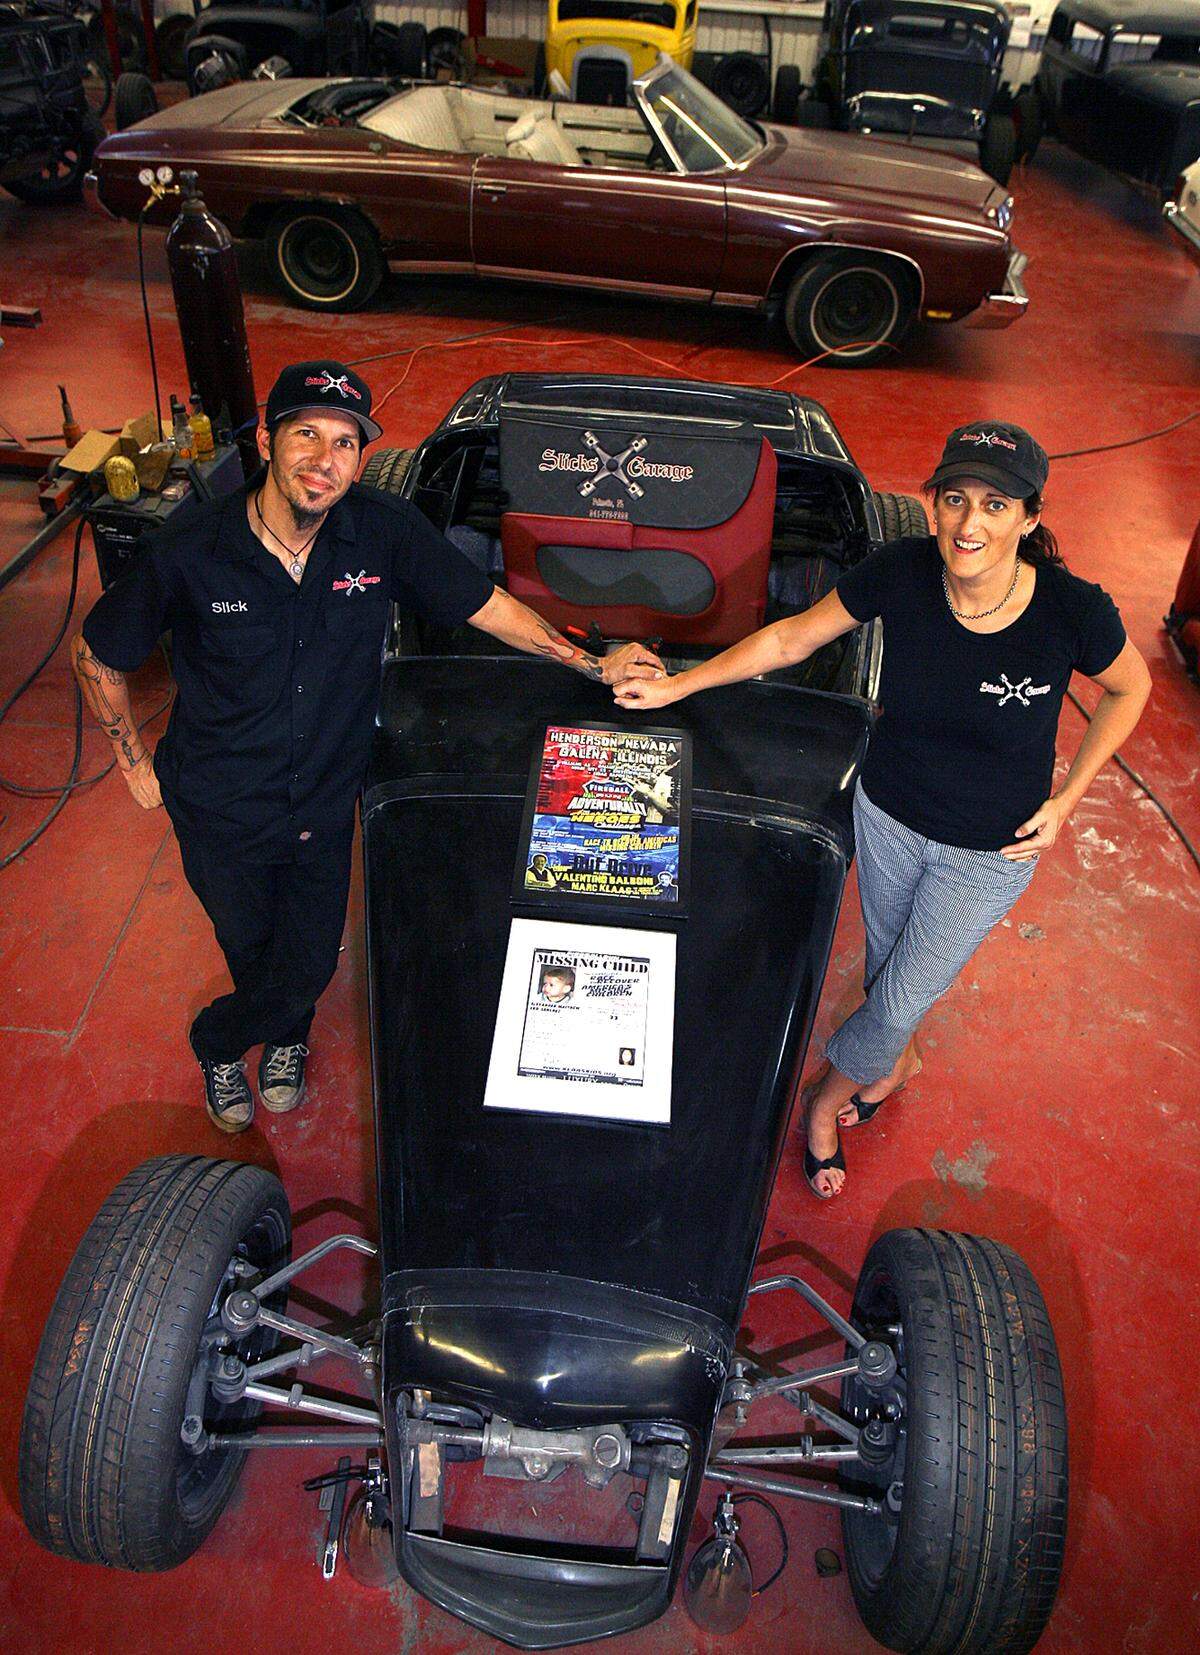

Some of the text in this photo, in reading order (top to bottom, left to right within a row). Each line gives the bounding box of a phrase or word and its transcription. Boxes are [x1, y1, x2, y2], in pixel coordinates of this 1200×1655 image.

[538, 448, 693, 482] Slicks Garage
[212, 600, 248, 614] Slick
[550, 732, 617, 748] HENDERSON
[625, 738, 677, 753] NEVADA
[616, 752, 667, 766] ILLINOIS
[589, 784, 630, 794] FIREBALL
[571, 814, 642, 824] HEROES
[555, 872, 654, 886] VALENTINO BALBONI
[571, 882, 598, 893] MARC
[536, 953, 649, 974] MISSING CHILD
